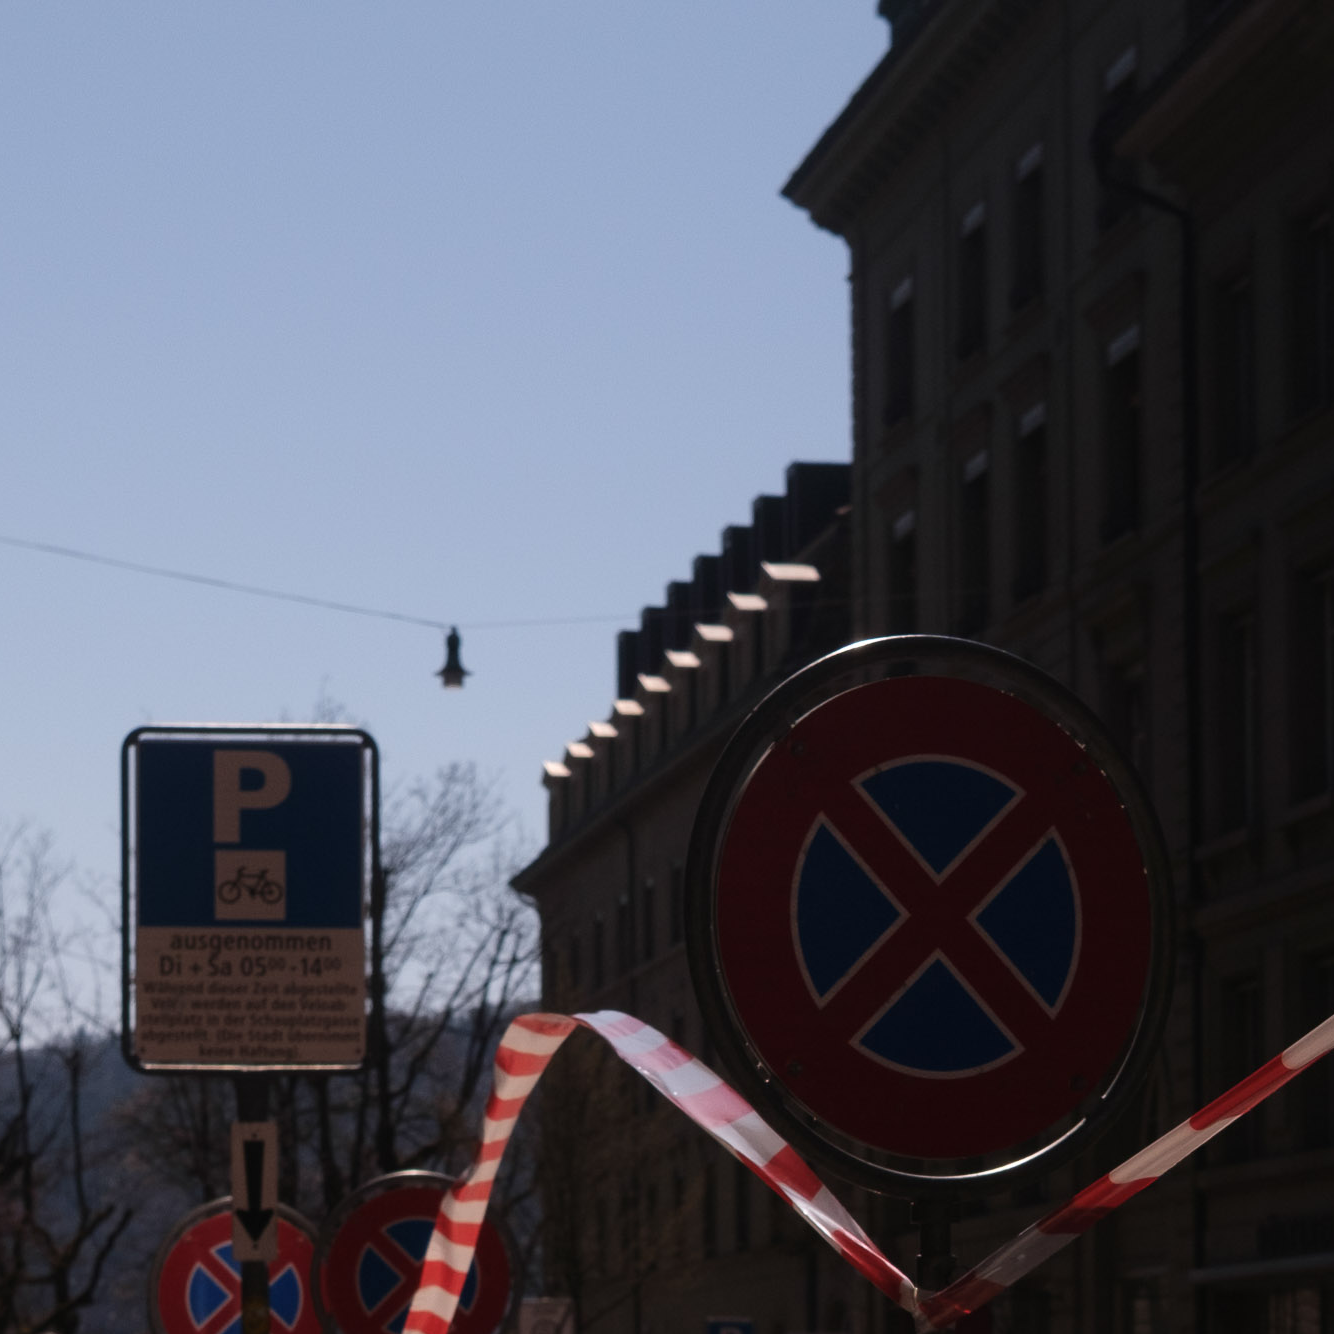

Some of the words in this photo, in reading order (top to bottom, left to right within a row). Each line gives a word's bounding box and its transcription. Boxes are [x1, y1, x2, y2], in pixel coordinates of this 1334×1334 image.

[213, 749, 292, 844] P
[170, 934, 332, 956] ausgenommen
[159, 954, 182, 976] Di
[190, 962, 203, 974] +
[208, 955, 232, 977] Sa
